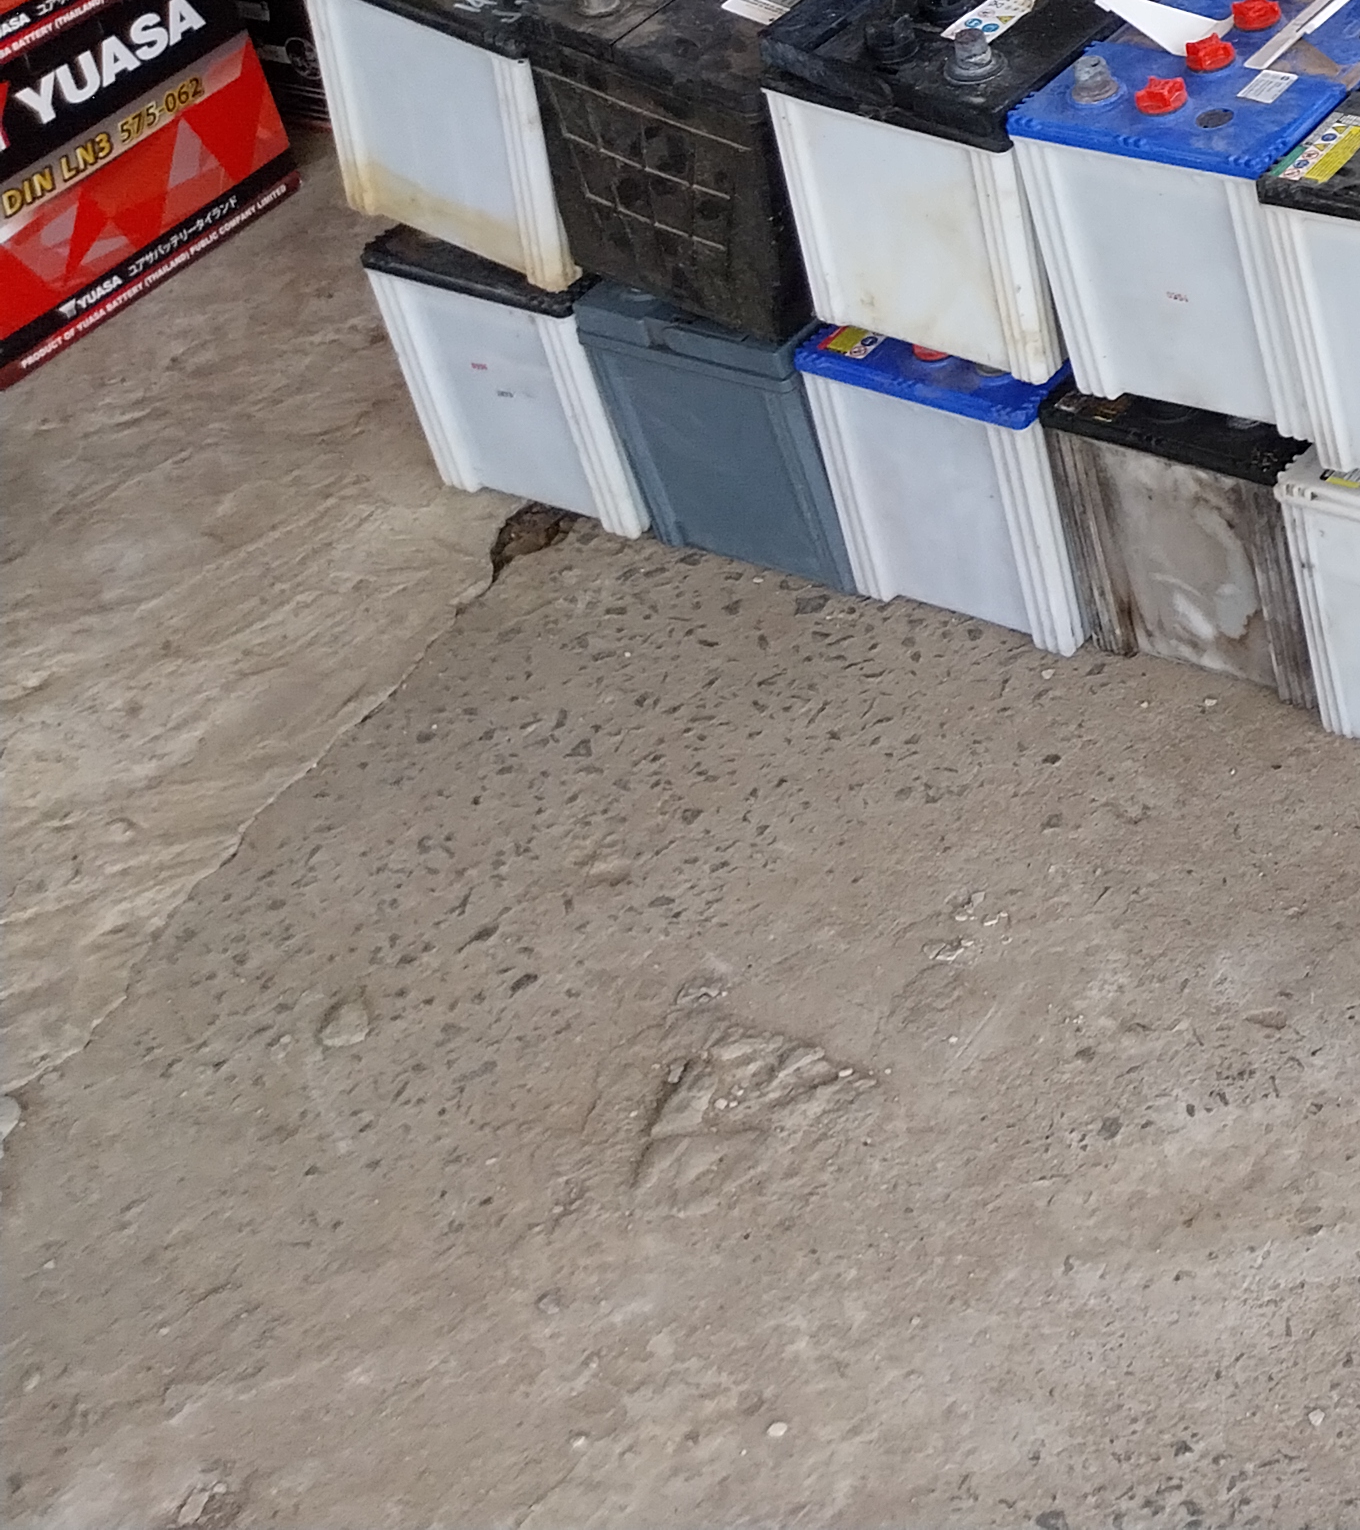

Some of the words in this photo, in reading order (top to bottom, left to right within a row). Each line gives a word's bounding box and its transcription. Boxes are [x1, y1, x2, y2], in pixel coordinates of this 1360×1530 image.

[2, 171, 53, 217] DIN
[62, 132, 114, 182] LN3
[119, 77, 203, 145] 575-062
[77, 274, 124, 310] YUASA
